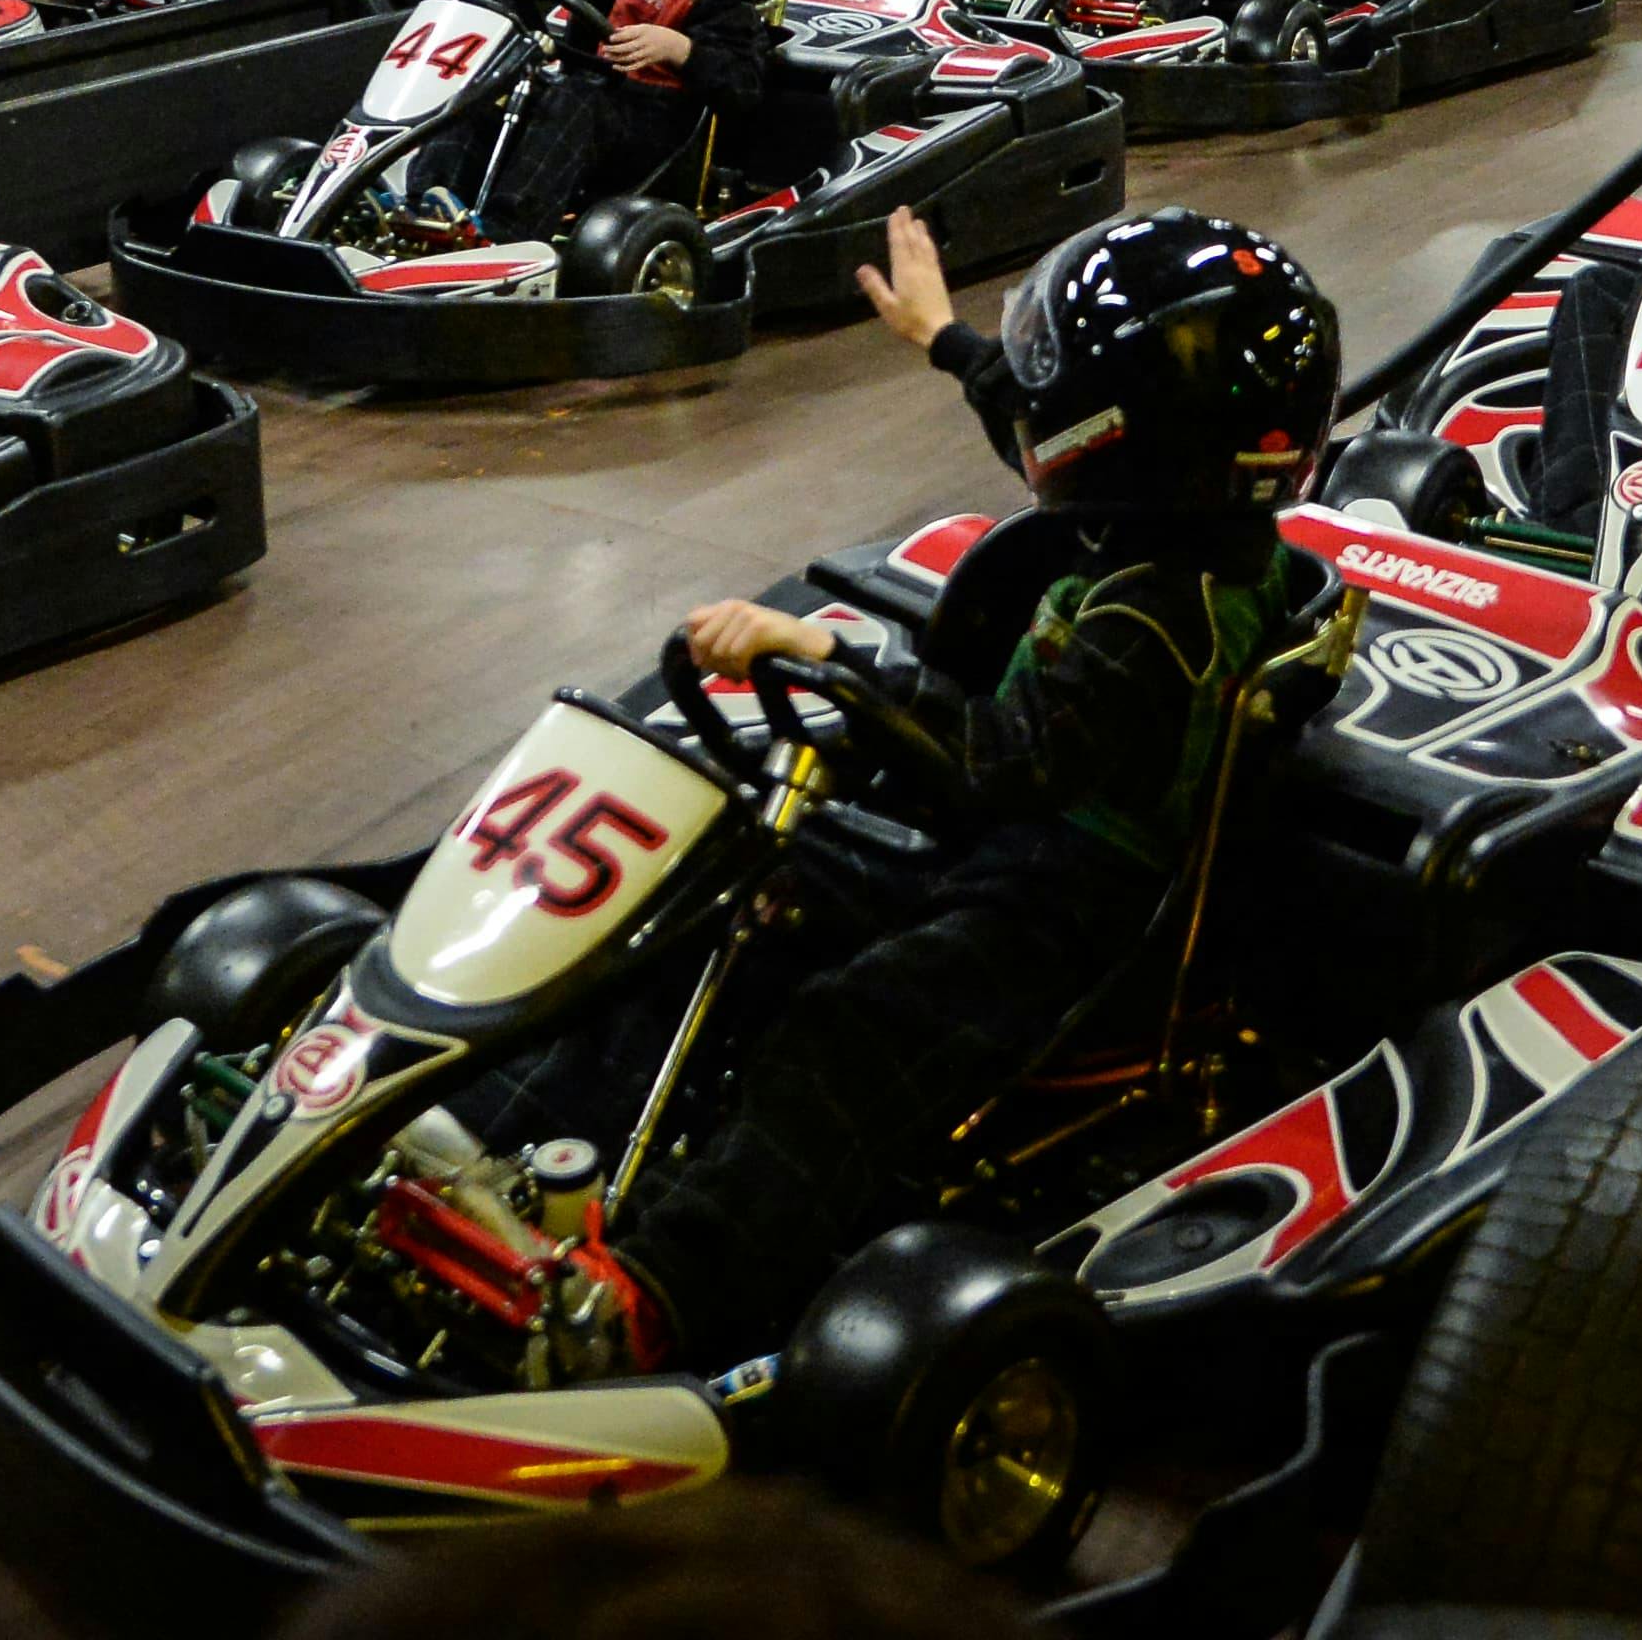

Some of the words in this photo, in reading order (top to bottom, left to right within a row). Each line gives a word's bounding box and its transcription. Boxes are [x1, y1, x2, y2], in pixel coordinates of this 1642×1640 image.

[382, 21, 488, 81] 44
[1335, 542, 1500, 609] BIZKARTS
[455, 770, 671, 918] 45
